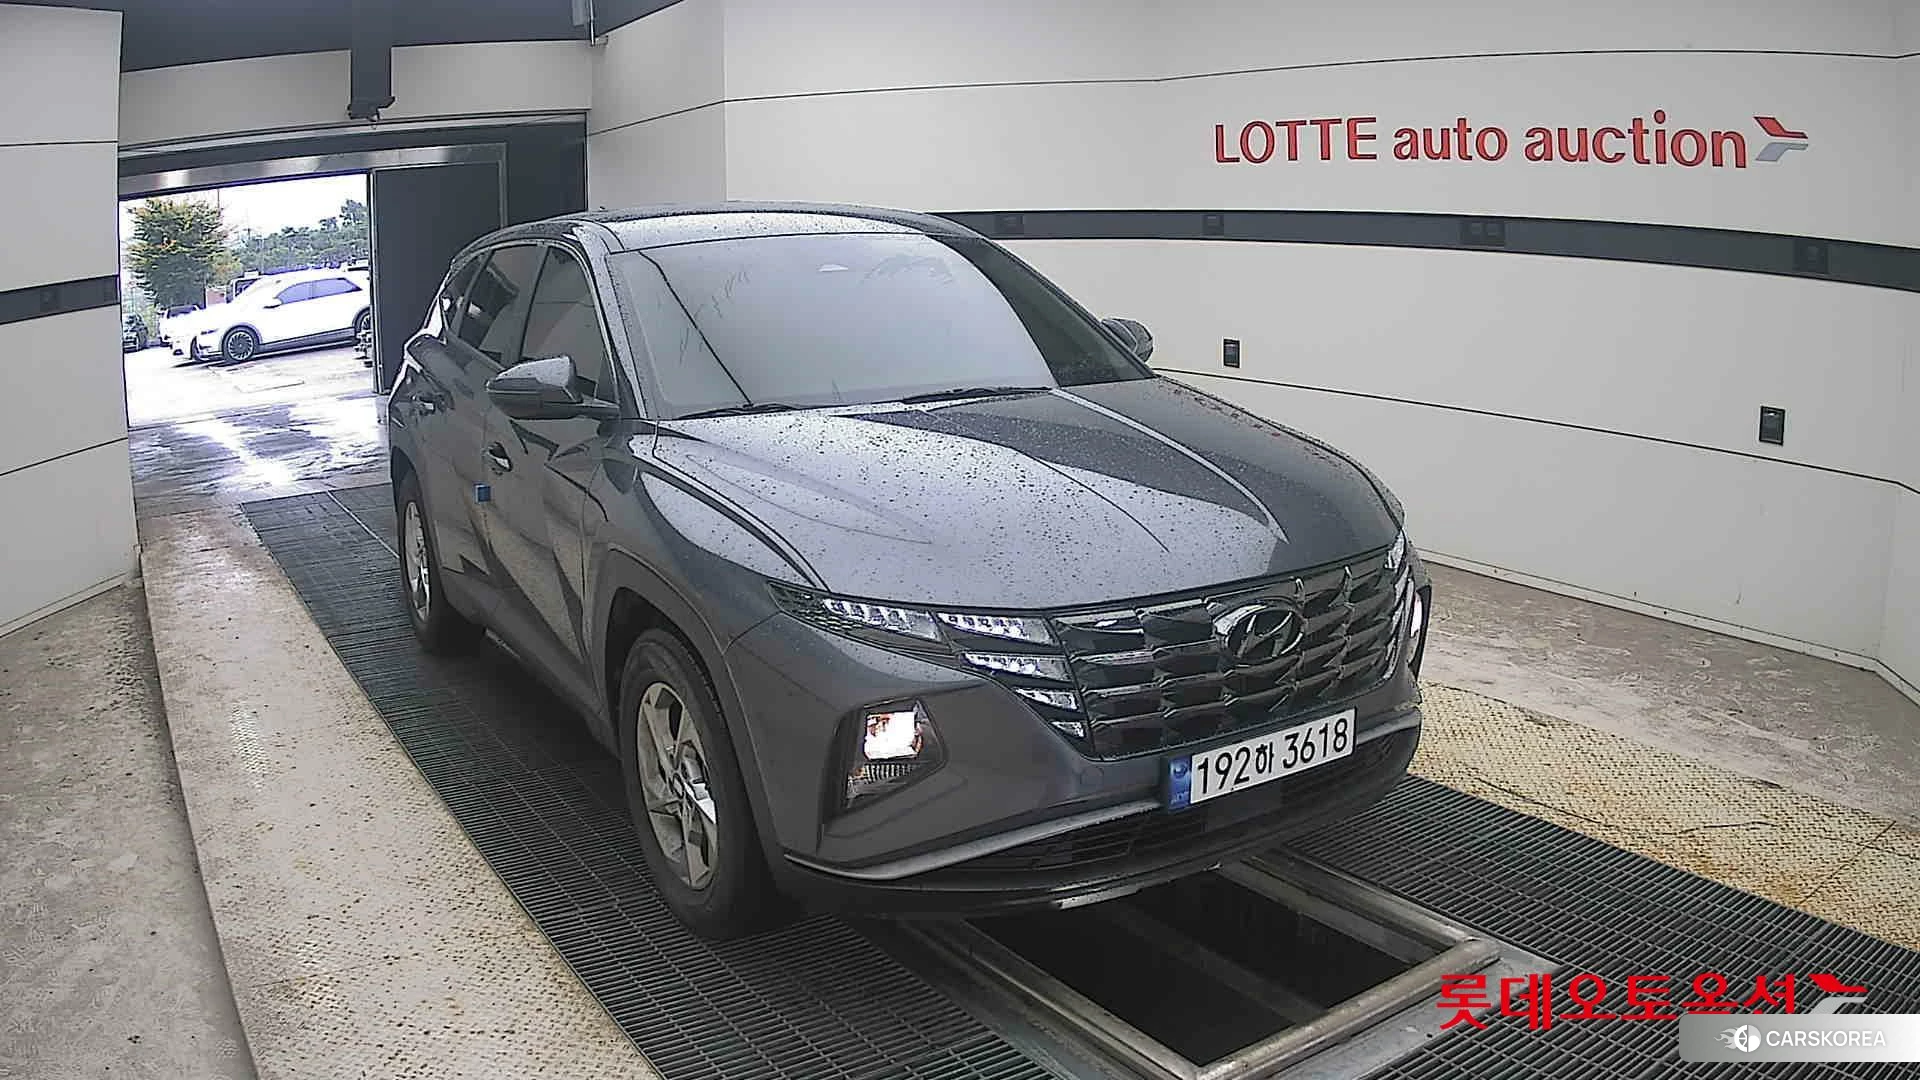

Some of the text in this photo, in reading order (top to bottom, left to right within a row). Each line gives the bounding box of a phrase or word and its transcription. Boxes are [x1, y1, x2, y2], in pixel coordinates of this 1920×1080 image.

[1214, 110, 1748, 169] LOTTE auto auction
[1197, 717, 1349, 795] 192하 3618
